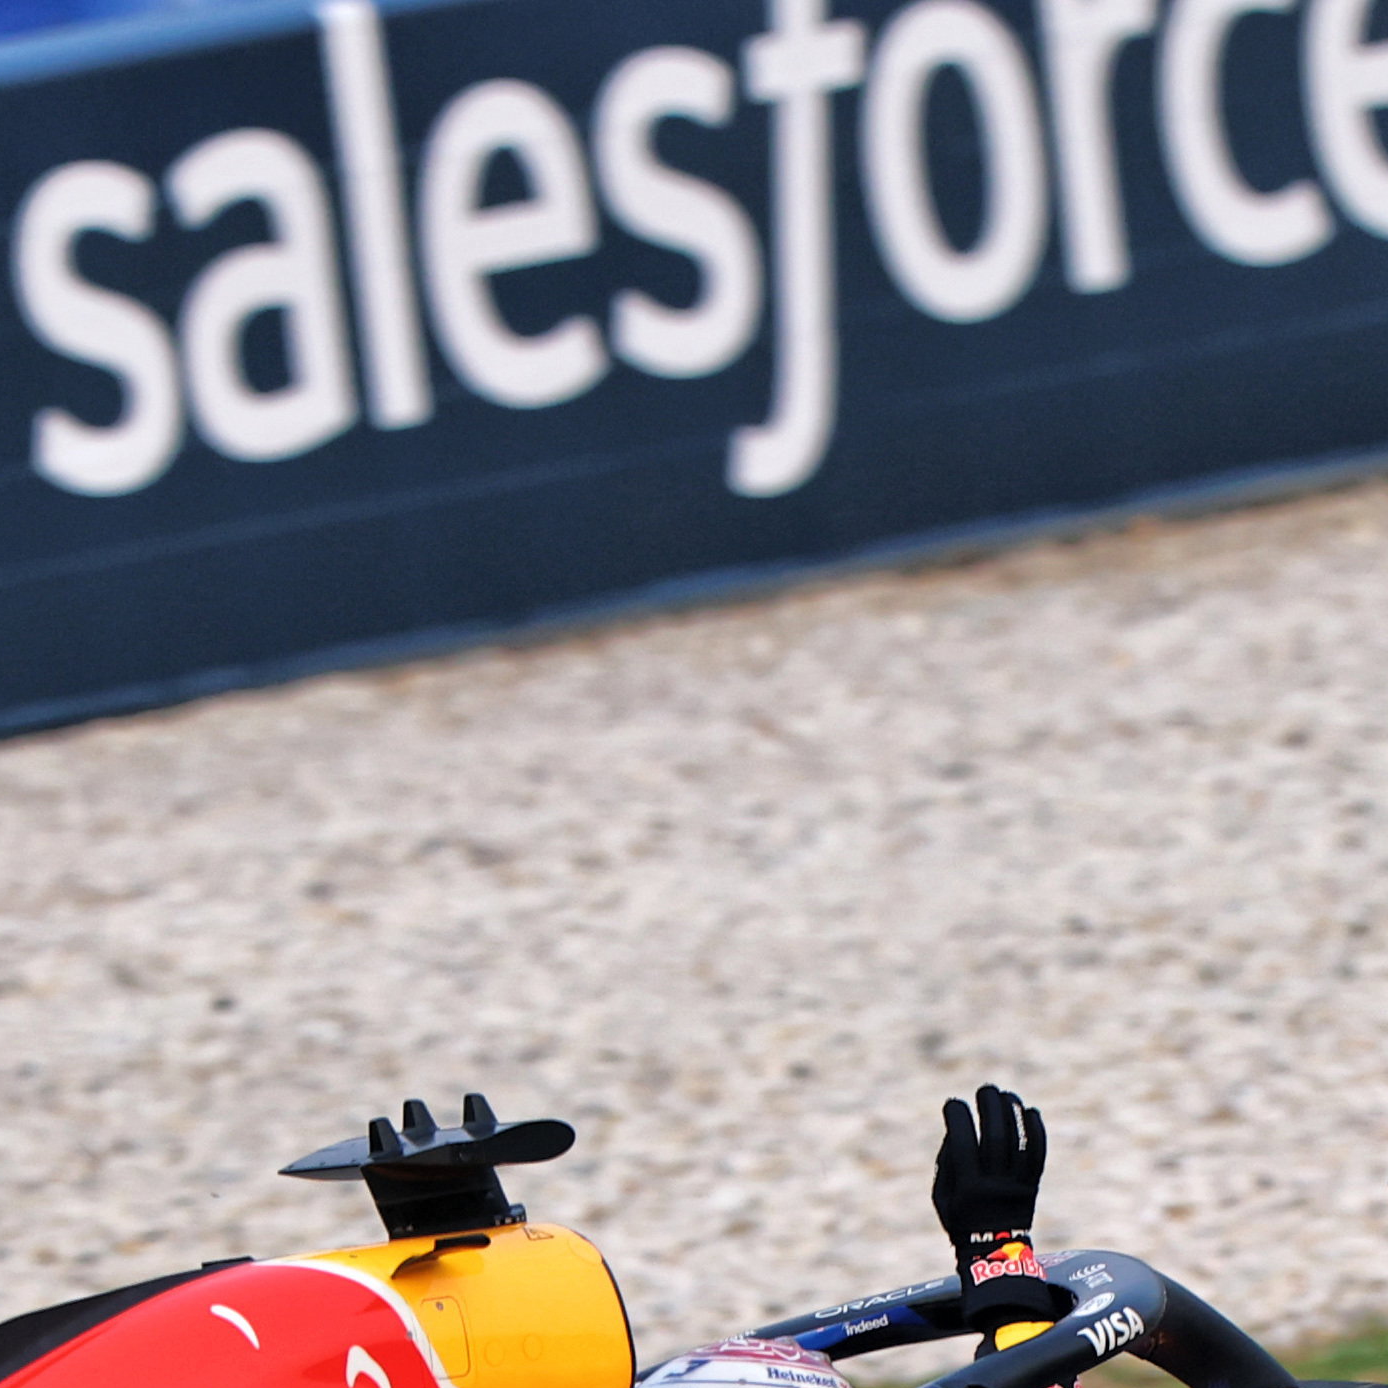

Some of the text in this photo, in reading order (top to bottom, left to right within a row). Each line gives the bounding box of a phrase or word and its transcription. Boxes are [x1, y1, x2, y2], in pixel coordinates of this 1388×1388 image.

[970, 1257, 1023, 1286] Red
[815, 1279, 945, 1319] ORACLE
[844, 1314, 889, 1337] indeed
[1077, 1306, 1145, 1357] VISA
